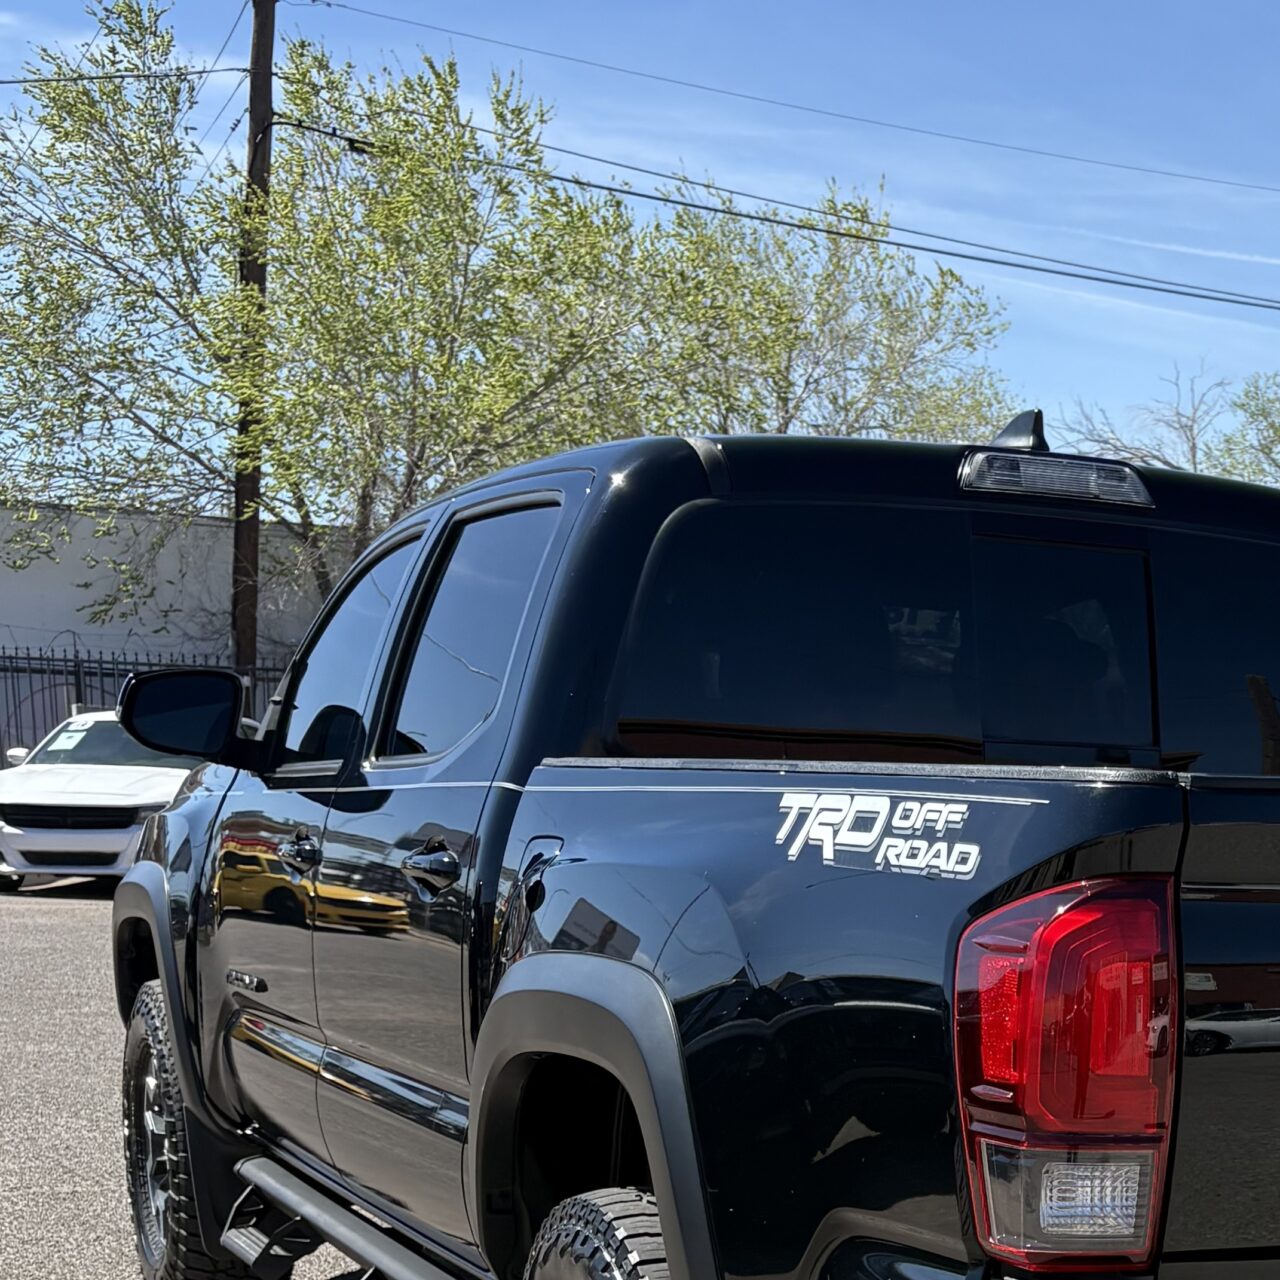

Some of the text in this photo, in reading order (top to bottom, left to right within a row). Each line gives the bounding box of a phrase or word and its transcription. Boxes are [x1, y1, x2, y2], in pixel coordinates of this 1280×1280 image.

[775, 793, 970, 866] TRD OFF
[874, 837, 982, 880] ROAD
